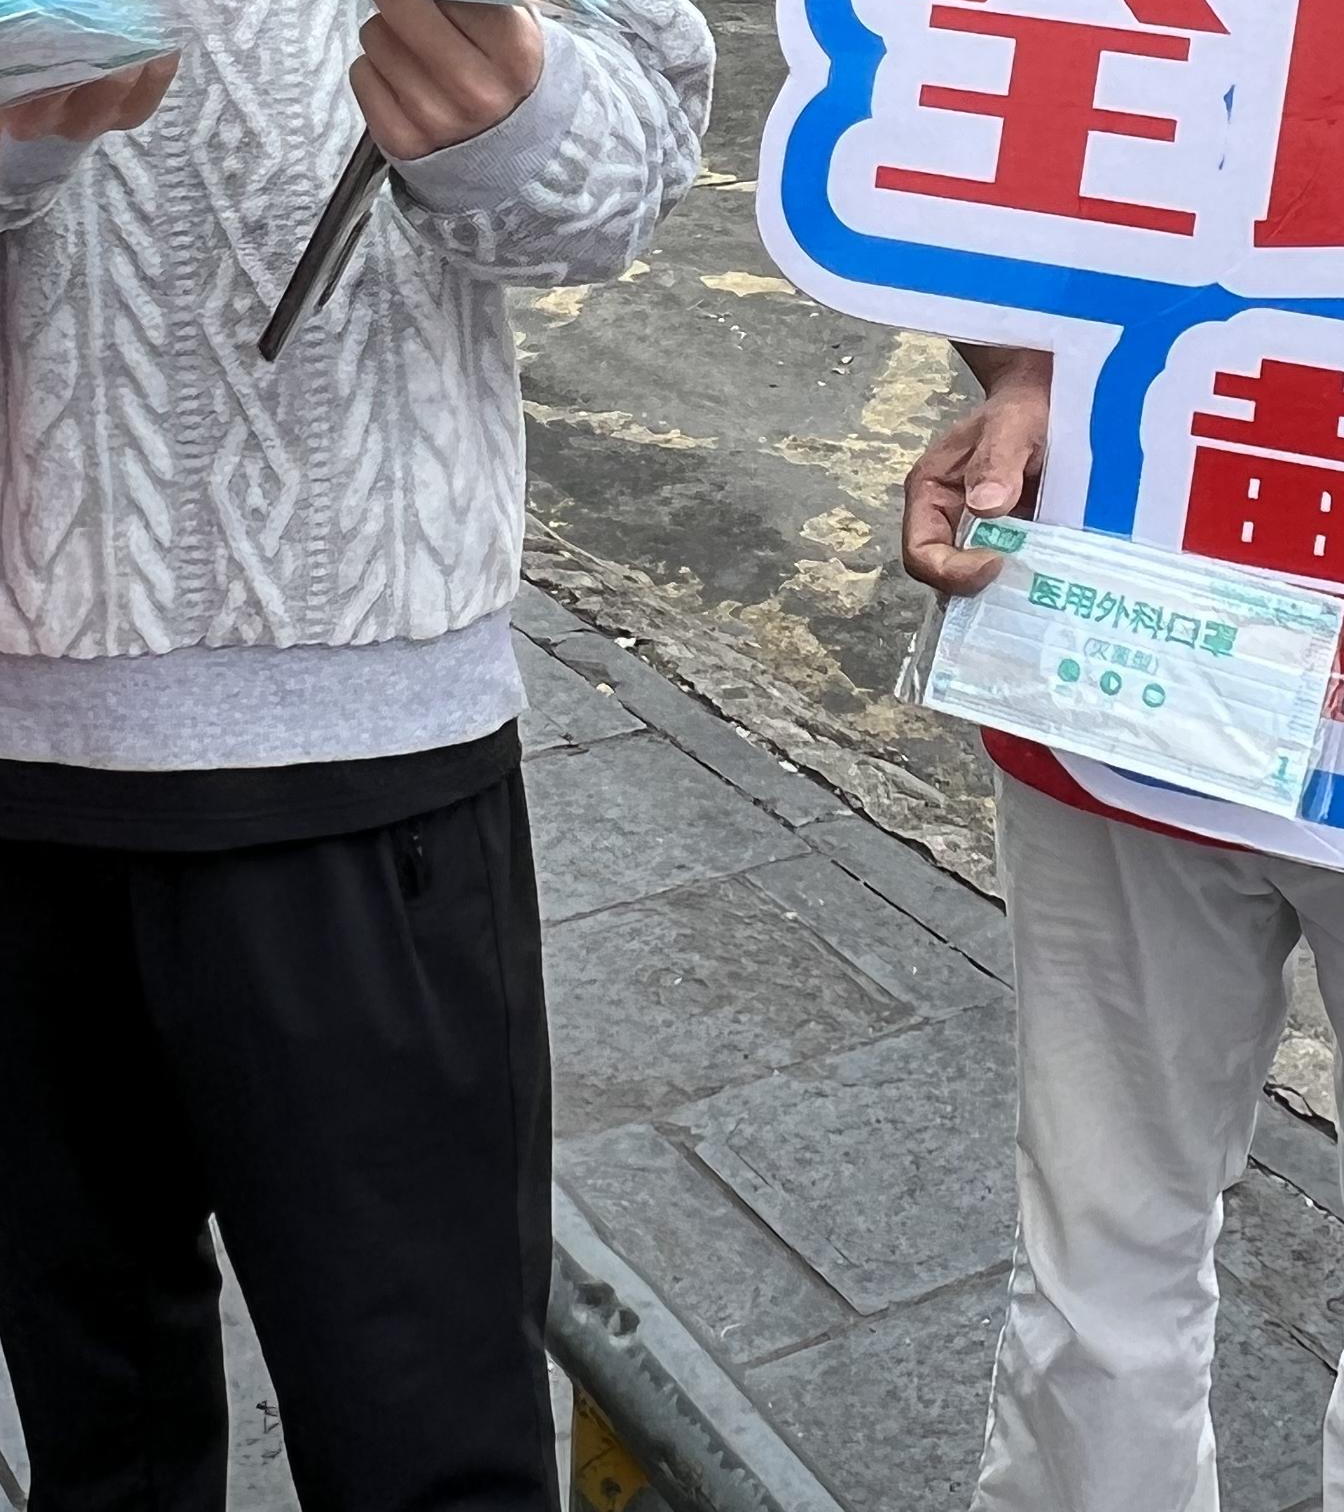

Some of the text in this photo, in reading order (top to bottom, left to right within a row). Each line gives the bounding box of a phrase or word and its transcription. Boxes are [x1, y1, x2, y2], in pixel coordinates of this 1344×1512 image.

[1028, 572, 1239, 658] 医用外科口罩
